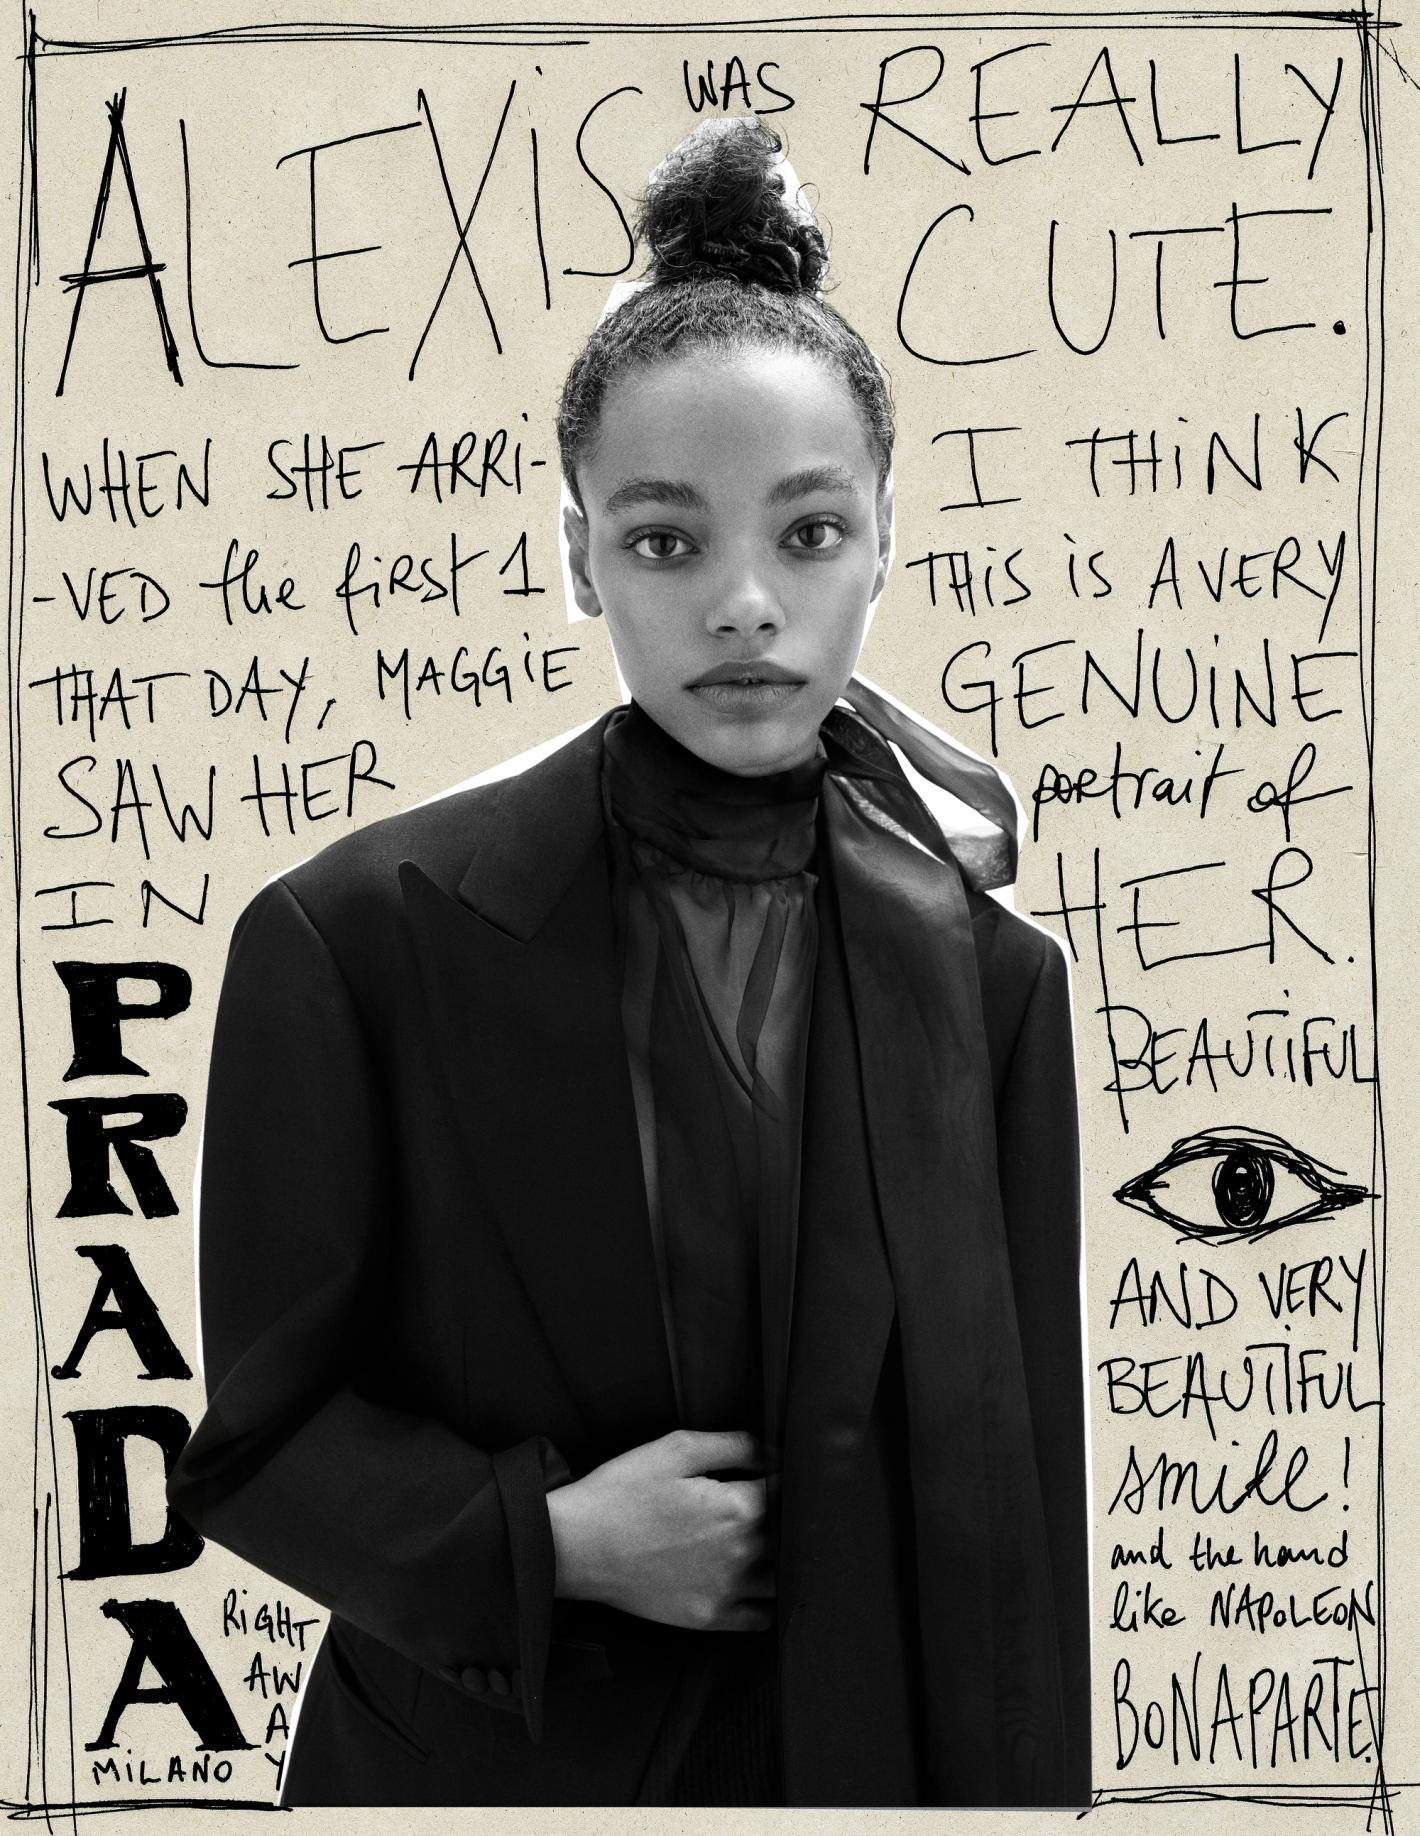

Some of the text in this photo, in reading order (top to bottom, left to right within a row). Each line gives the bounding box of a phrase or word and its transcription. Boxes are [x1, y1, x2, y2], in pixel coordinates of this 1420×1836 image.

[683, 57, 795, 114] WAS
[861, 43, 1344, 179] REALLY
[896, 203, 1348, 366] CUTE.
[43, 437, 212, 528] WHEN
[266, 433, 385, 511] SHE
[932, 407, 1349, 511] I THiNK
[33, 566, 170, 624] -VED
[200, 538, 305, 624] the
[906, 547, 1031, 616] THiS
[1148, 537, 1183, 609] A
[1198, 531, 1346, 643] VERY
[29, 633, 580, 743] THAT DAY, MAGGiE
[942, 629, 1357, 757] GENUiNE
[43, 741, 395, 860] SAW HER
[1246, 742, 1353, 842] of
[35, 874, 209, 930] IN
[1030, 848, 1355, 970] HER.
[1109, 1249, 1367, 1352] AND VERY
[46, 961, 262, 1753] PRADA
[1110, 1527, 1348, 1571] and the hand
[1110, 1580, 1187, 1631] like
[92, 1749, 233, 1786] MiLANO
